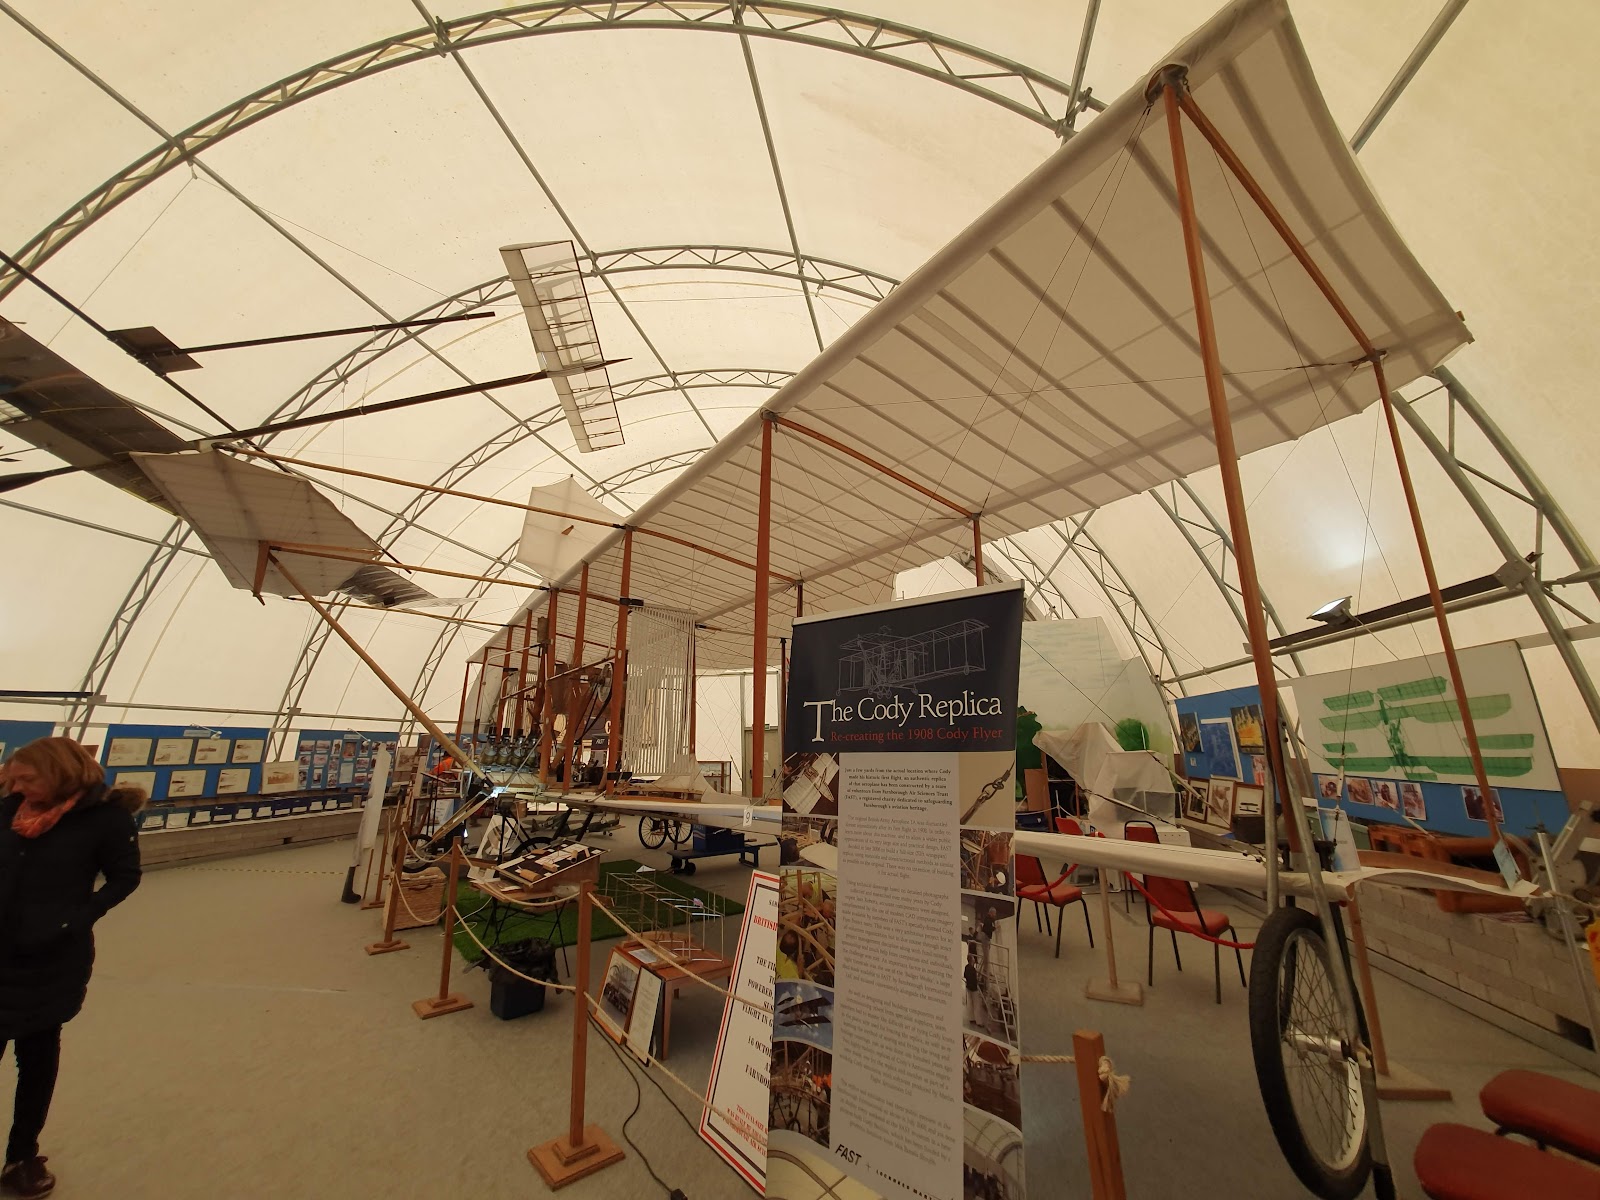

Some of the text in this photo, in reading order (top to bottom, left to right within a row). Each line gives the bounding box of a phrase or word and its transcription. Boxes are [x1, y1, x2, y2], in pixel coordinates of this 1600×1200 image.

[803, 690, 1002, 742] The Cody Replica
[831, 726, 1003, 743] Re-creating the 1908 Cody Flyer
[754, 915, 778, 931] BRITISH
[757, 956, 767, 967] THE
[748, 979, 774, 999] POWERED,
[835, 1144, 863, 1166] FAST
